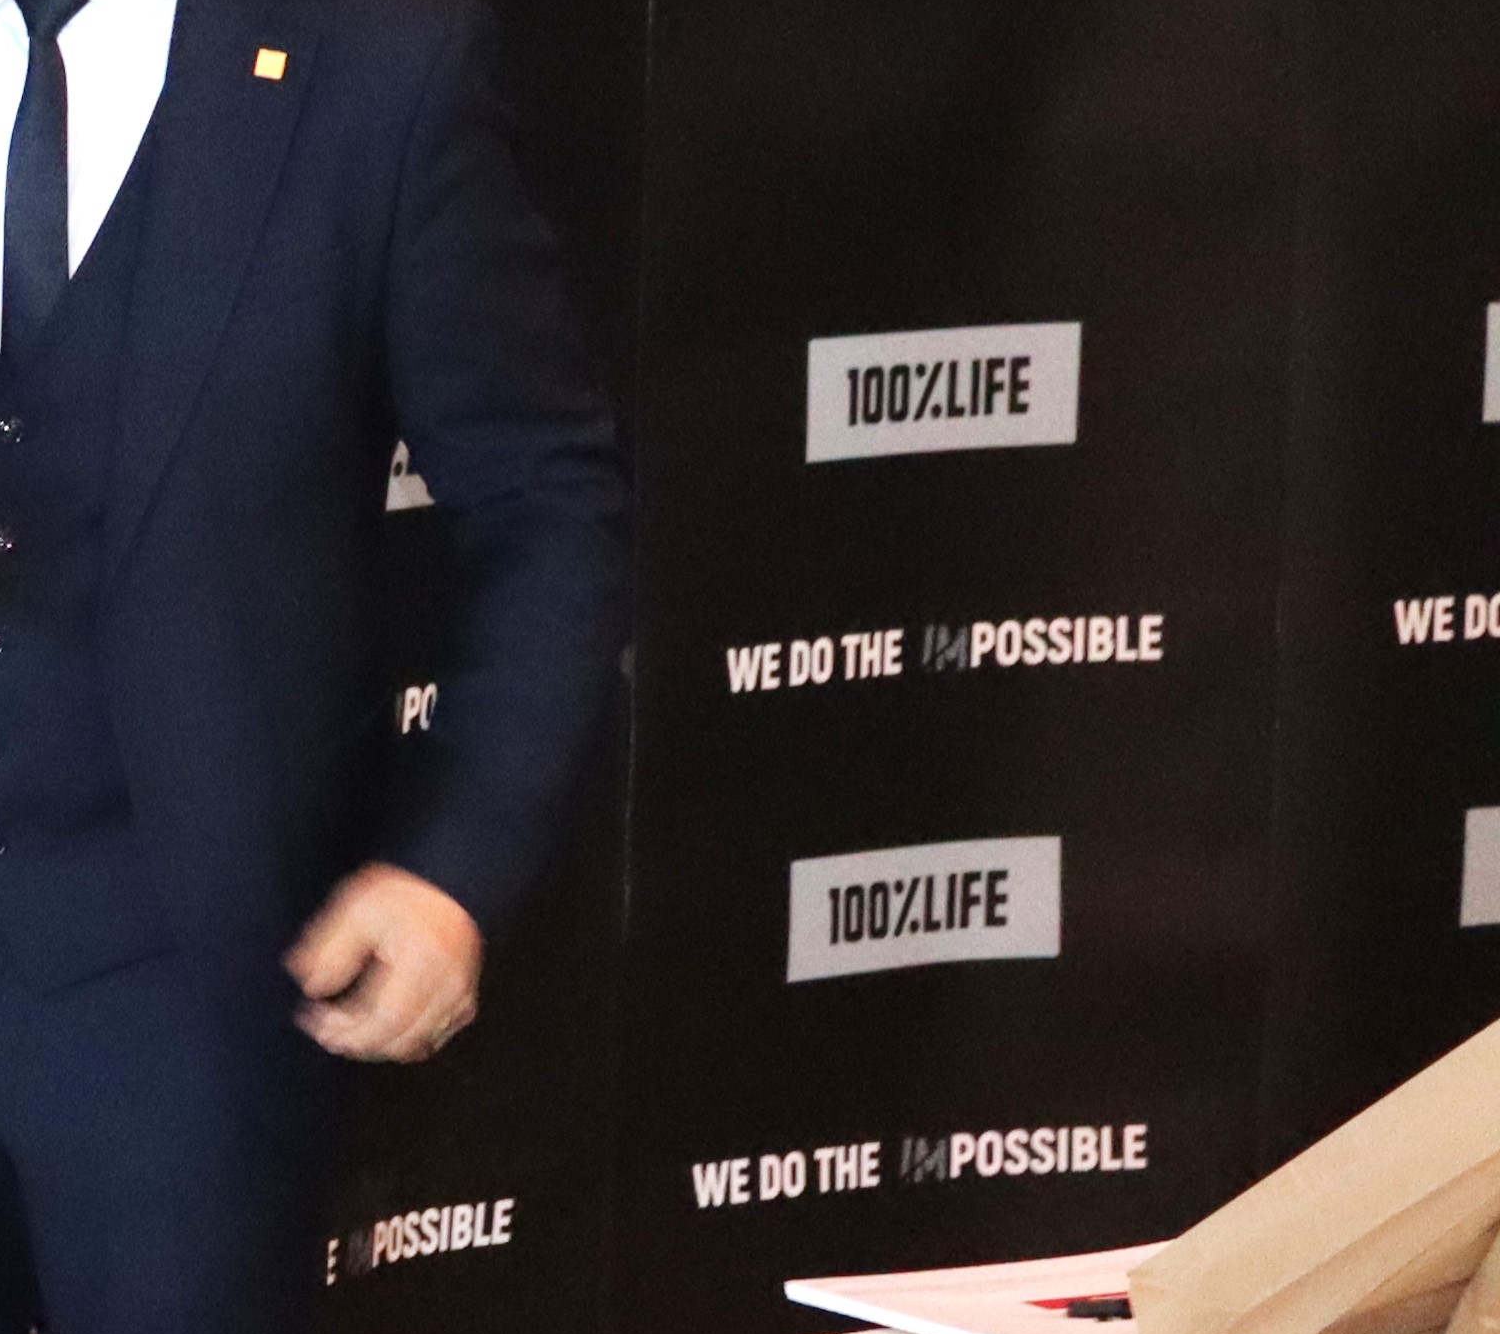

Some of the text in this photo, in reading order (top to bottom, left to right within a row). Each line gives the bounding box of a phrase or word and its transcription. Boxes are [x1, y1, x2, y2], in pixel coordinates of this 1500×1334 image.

[847, 356, 1031, 427] 100%LIFE
[1393, 595, 1455, 646] WE
[726, 644, 781, 693] WE
[788, 637, 834, 687] DO
[841, 629, 904, 681] THE
[828, 870, 1008, 946] 100%LIFE
[692, 1158, 750, 1208] WE
[759, 1151, 806, 1201] DO
[814, 1141, 881, 1193] THE
